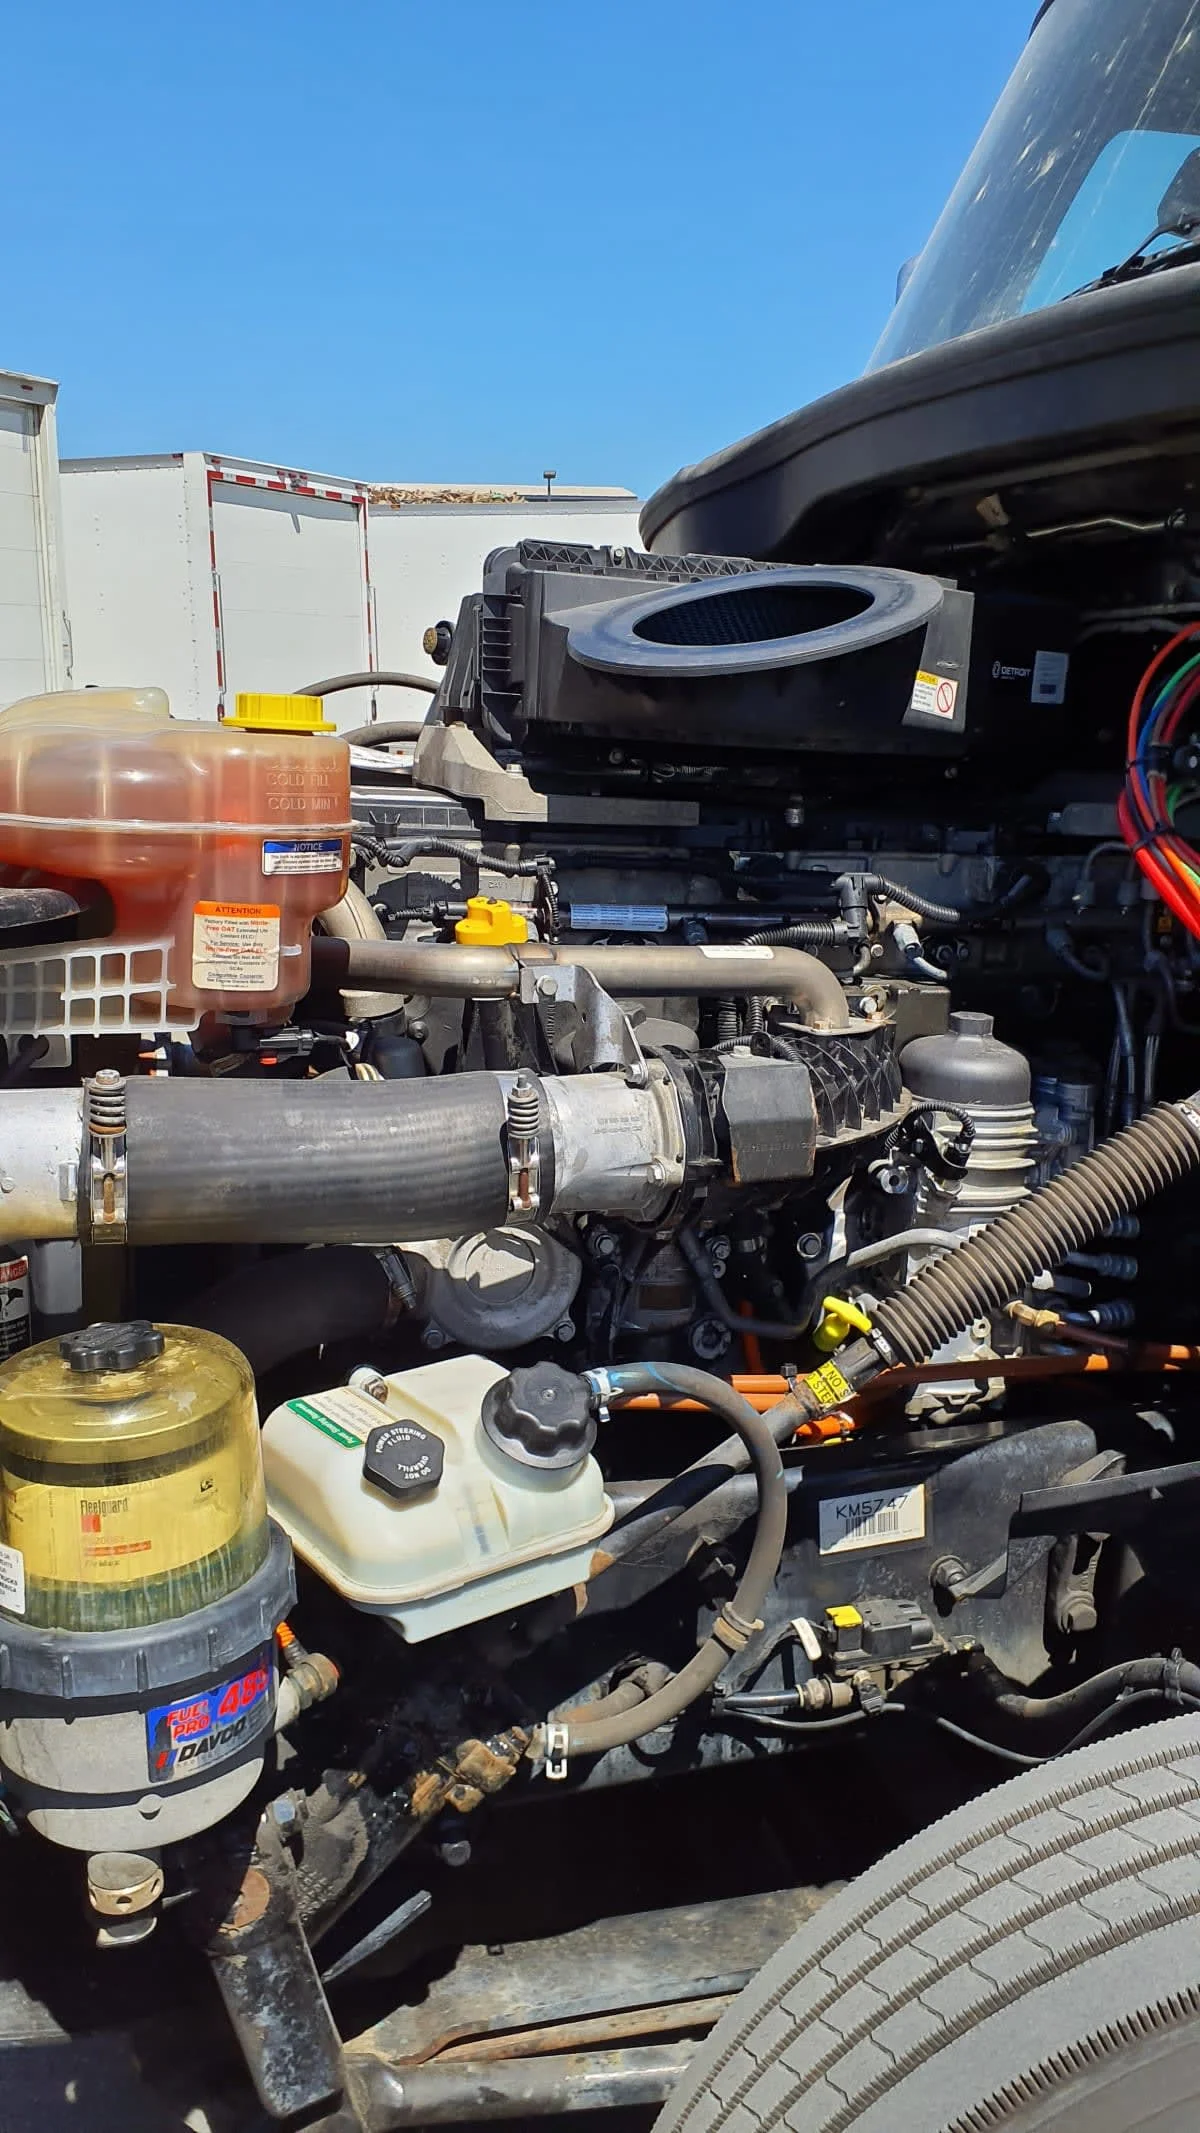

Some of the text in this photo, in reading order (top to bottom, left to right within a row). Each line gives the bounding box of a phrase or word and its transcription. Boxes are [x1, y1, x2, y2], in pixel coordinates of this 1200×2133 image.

[1001, 666, 1032, 677] DETROIT
[267, 773, 304, 786] COLD
[268, 797, 306, 810] COLD
[294, 842, 324, 852] NOTICE
[215, 906, 262, 915] ATTENTION
[826, 1370, 842, 1388] NO
[375, 1427, 427, 1454] POWER STEERING
[387, 1434, 411, 1447] FLUID
[397, 1455, 430, 1473] OVERFILL
[404, 1466, 432, 1480] DO NOT
[80, 1498, 129, 1517] Fleetguard
[835, 1494, 909, 1520] KM5747
[173, 1715, 210, 1740] PRO
